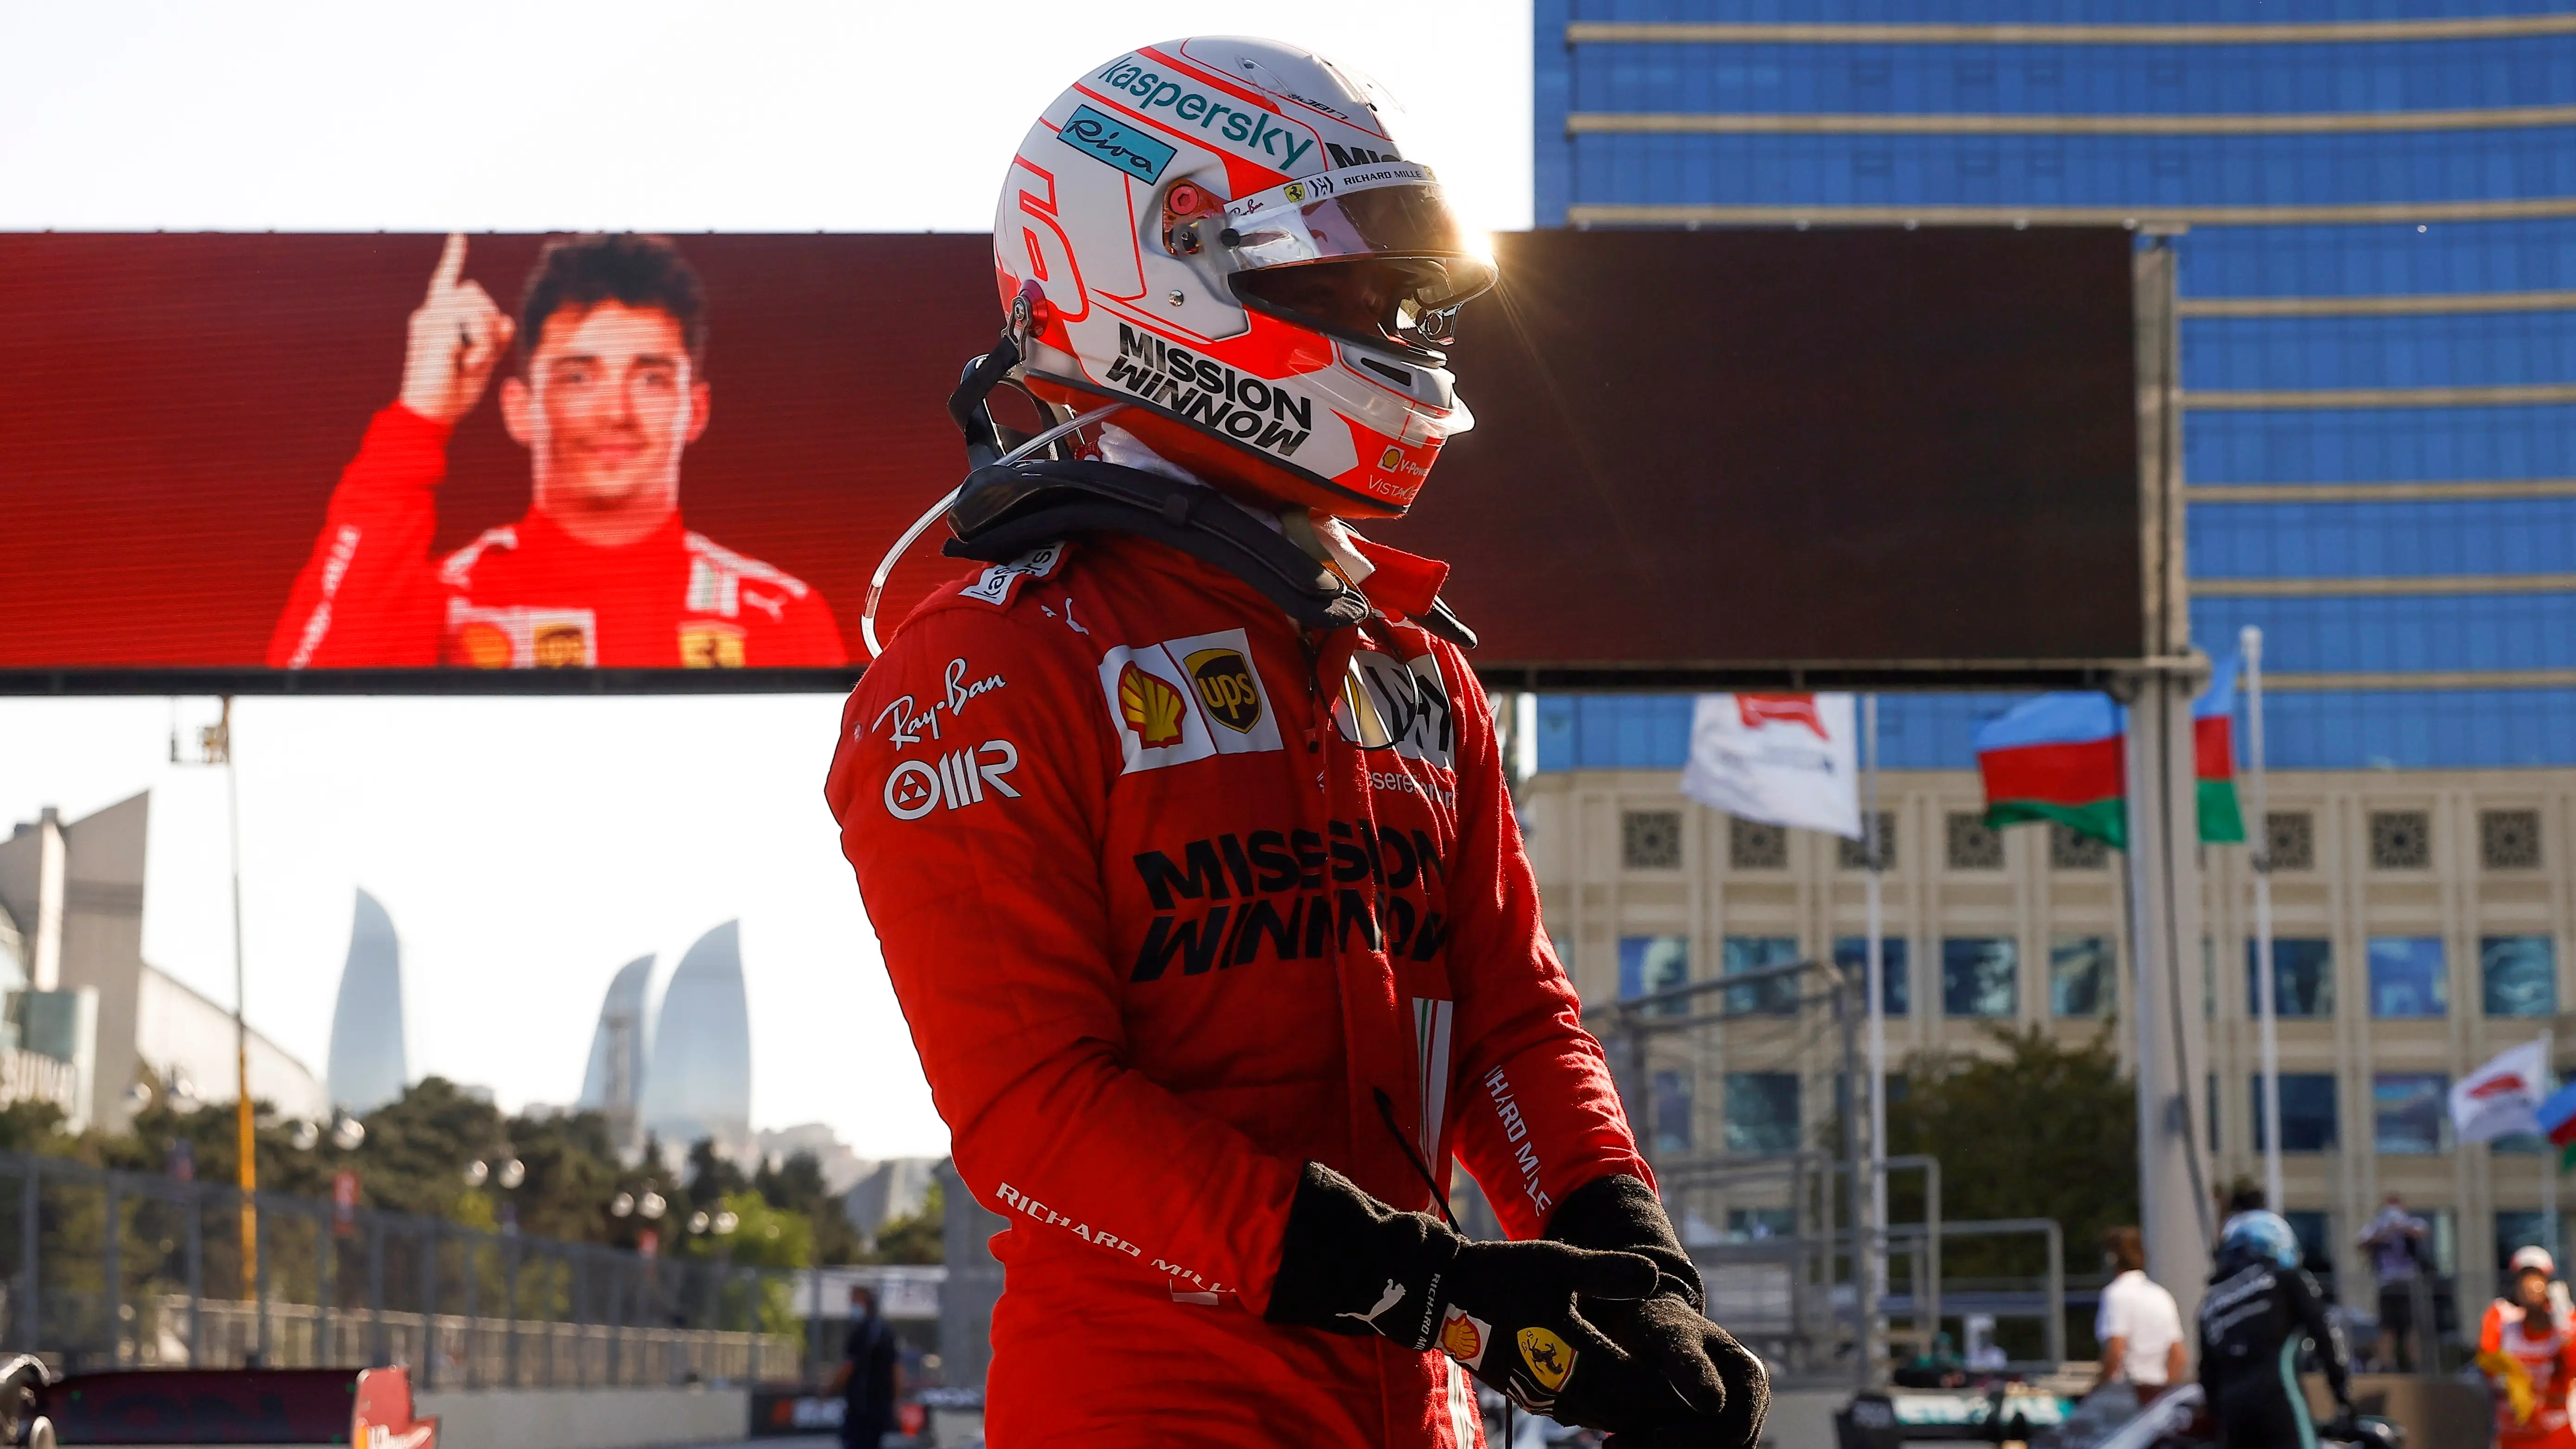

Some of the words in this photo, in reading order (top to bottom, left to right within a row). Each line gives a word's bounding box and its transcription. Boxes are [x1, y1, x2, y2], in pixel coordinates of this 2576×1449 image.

[1066, 120, 1153, 175] Riva
[1098, 56, 1313, 170] kaspersky
[1344, 171, 1392, 185] RICHARD
[1106, 355, 1310, 456] WINNOW
[1119, 323, 1312, 431] MISSION
[872, 658, 1006, 751] Ray-Ban
[1199, 677, 1256, 720] ups
[995, 1182, 1141, 1257] RICHARD
[1421, 1273, 1441, 1335] RICHARD
